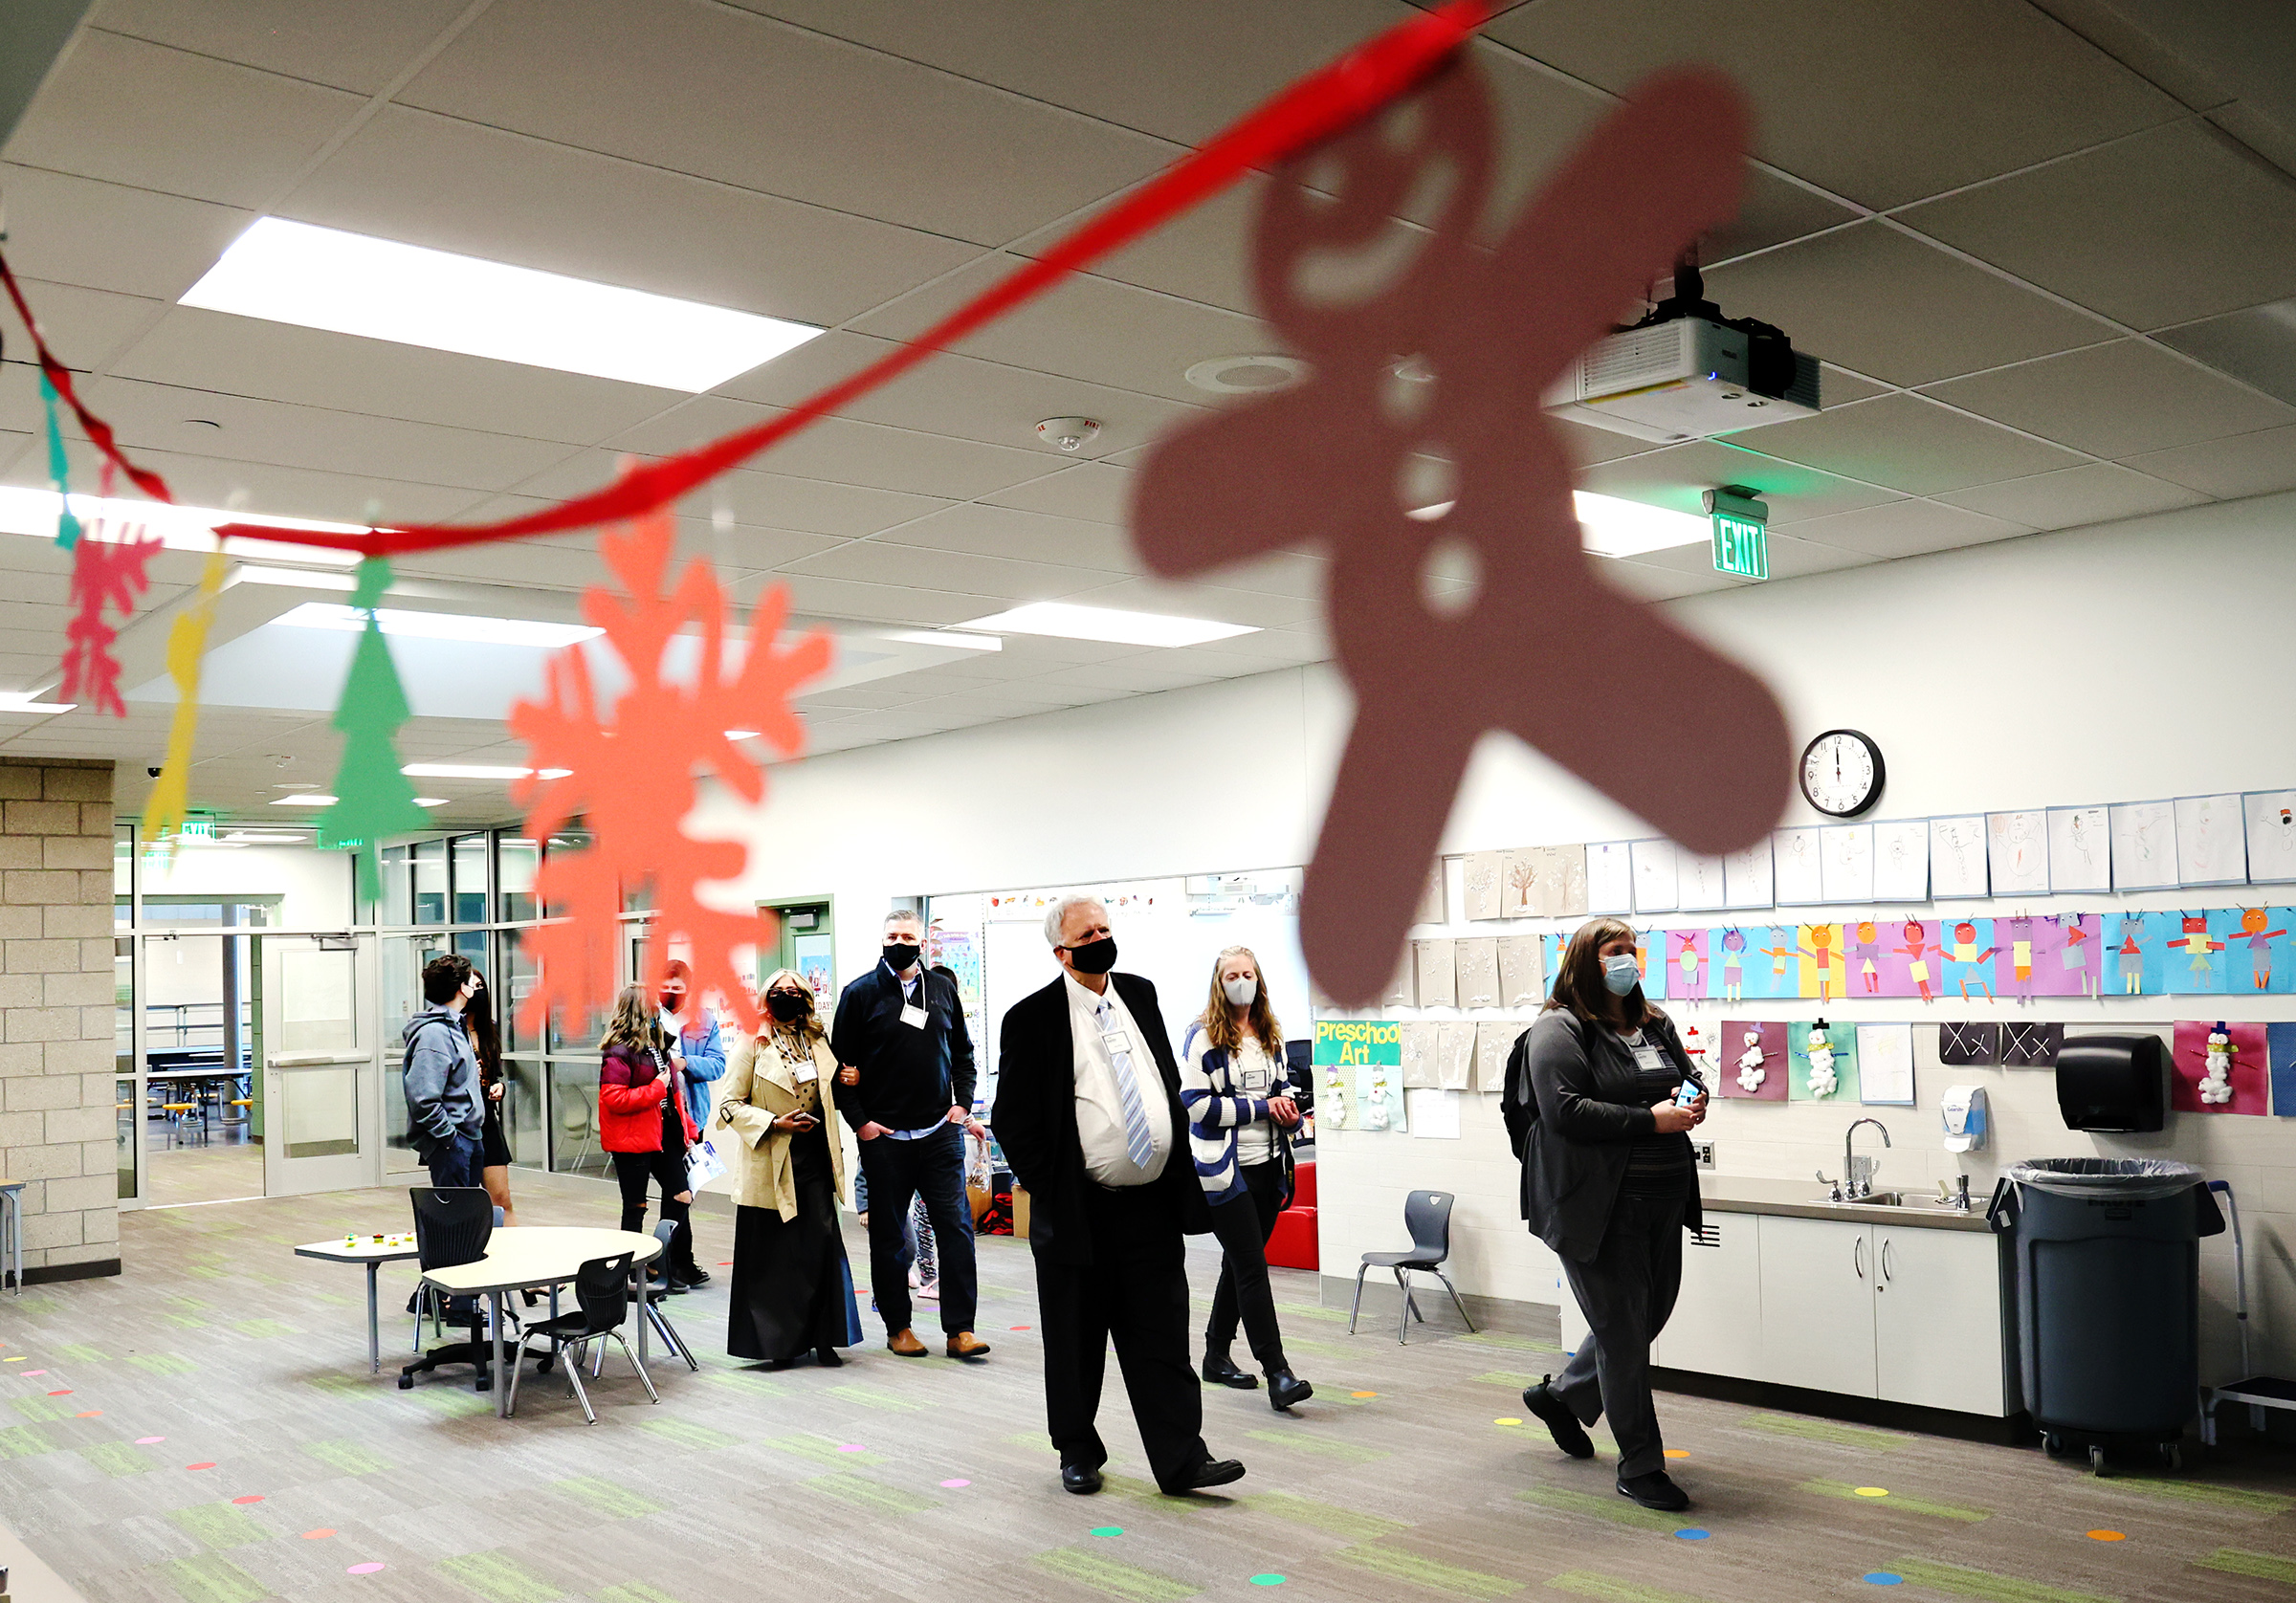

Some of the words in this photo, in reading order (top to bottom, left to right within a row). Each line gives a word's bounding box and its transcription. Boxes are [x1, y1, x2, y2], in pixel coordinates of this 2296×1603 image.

[1720, 519, 1759, 575] EXIT
[1834, 736, 1842, 744] 12
[1866, 766, 1871, 775] 3
[1808, 771, 1814, 780] 9
[1813, 788, 1819, 797] 8
[1825, 799, 1829, 807] 7
[1853, 796, 1858, 805] 5
[1838, 802, 1844, 810] 6
[1339, 1042, 1369, 1065] Art
